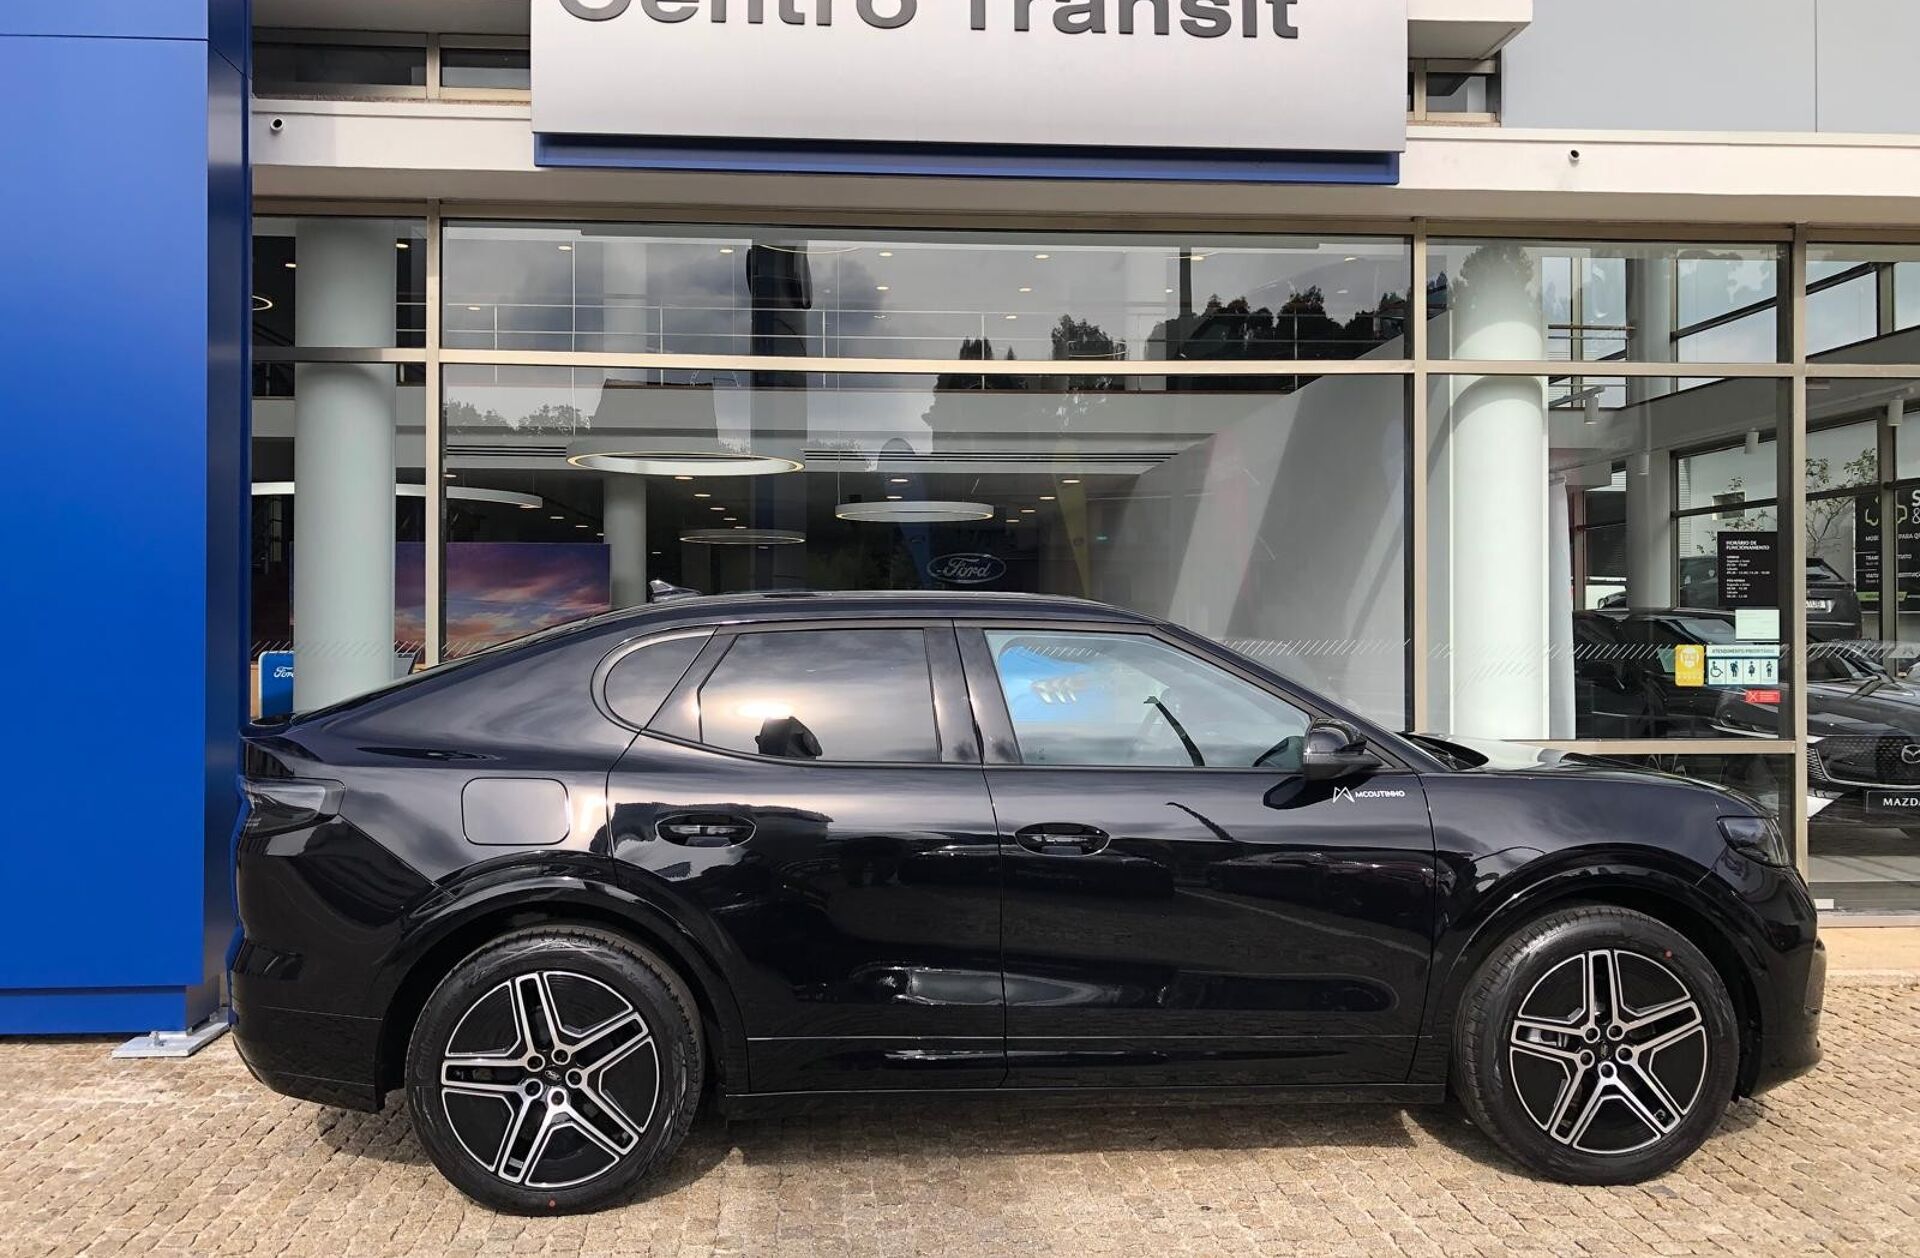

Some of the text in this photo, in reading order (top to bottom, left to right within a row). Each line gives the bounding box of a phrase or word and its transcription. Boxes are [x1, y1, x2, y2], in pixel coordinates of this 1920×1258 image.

[936, 556, 992, 578] Ford
[273, 665, 295, 678] For
[1355, 790, 1406, 798] MCOUTINHO
[1882, 797, 1920, 807] MAZD
